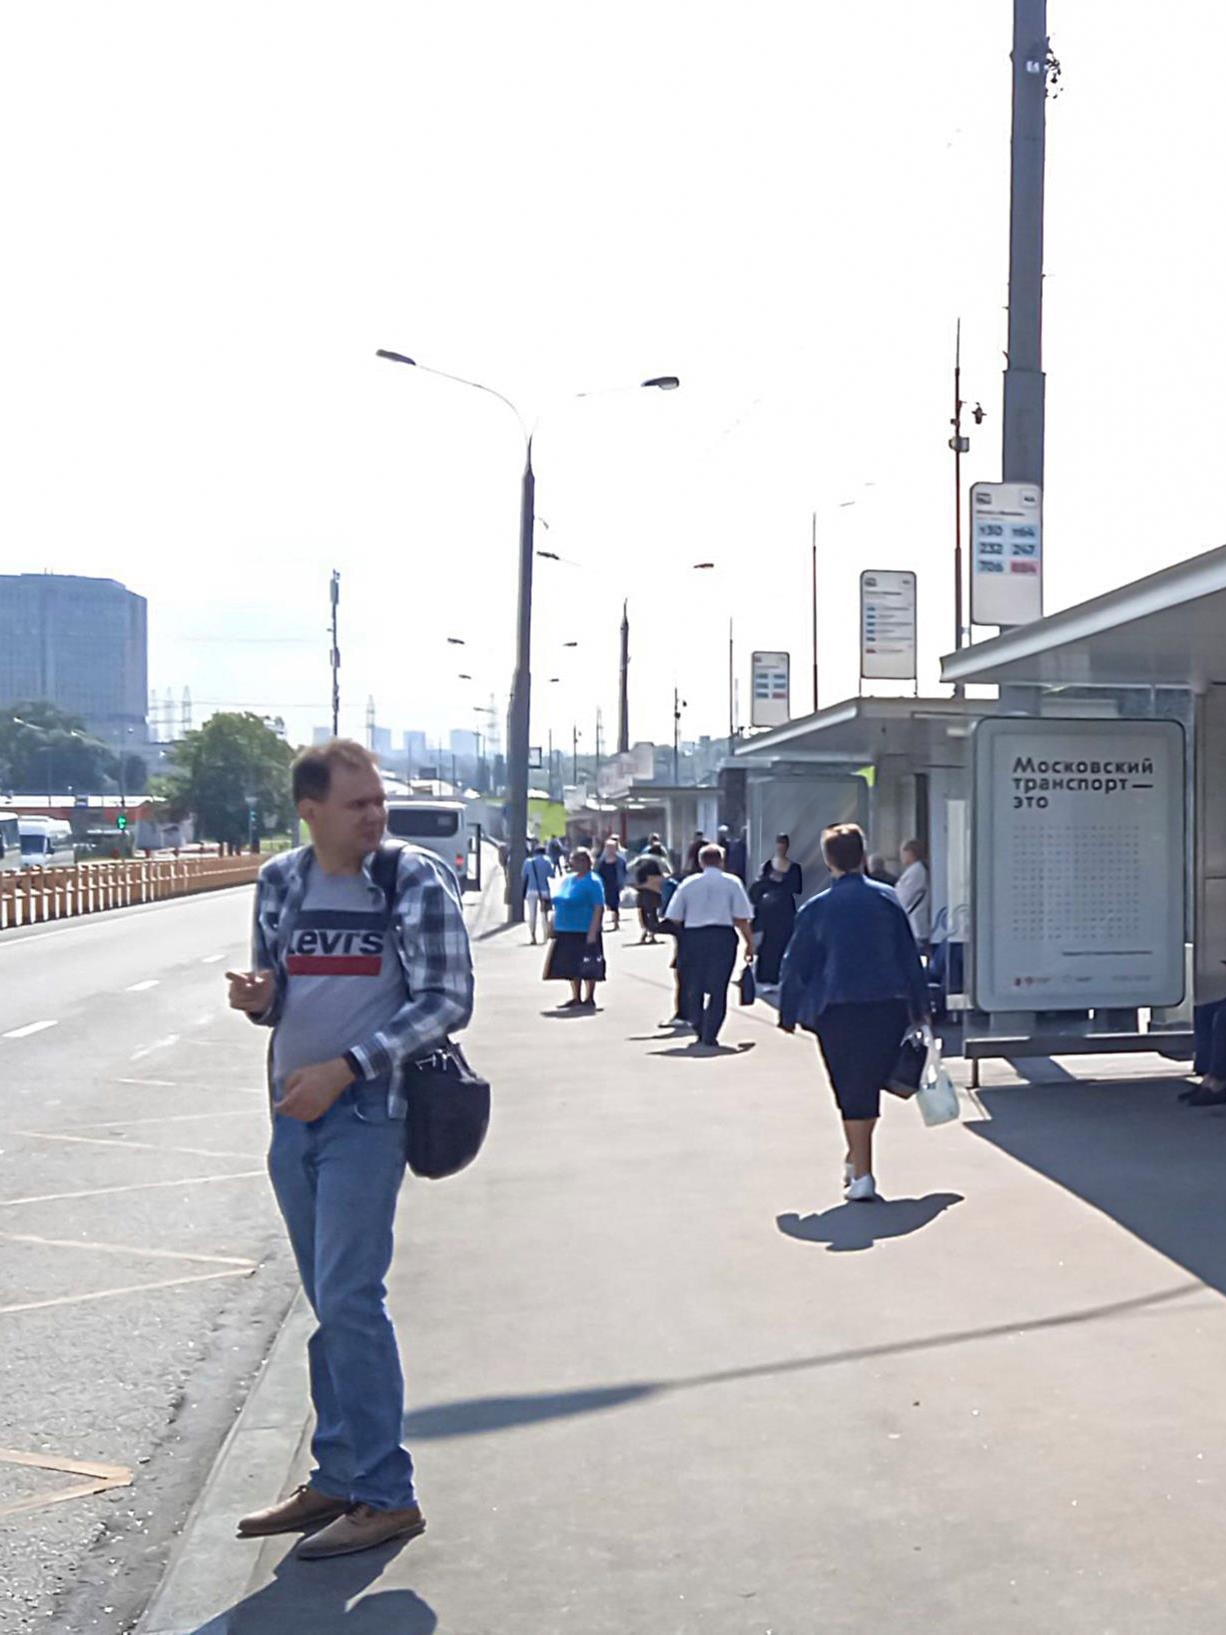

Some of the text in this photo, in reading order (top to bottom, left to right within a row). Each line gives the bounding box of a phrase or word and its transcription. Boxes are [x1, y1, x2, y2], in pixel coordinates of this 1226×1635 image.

[1013, 757, 1153, 774] Московский
[1013, 777, 1129, 794] транспорт
[1013, 795, 1049, 809] это
